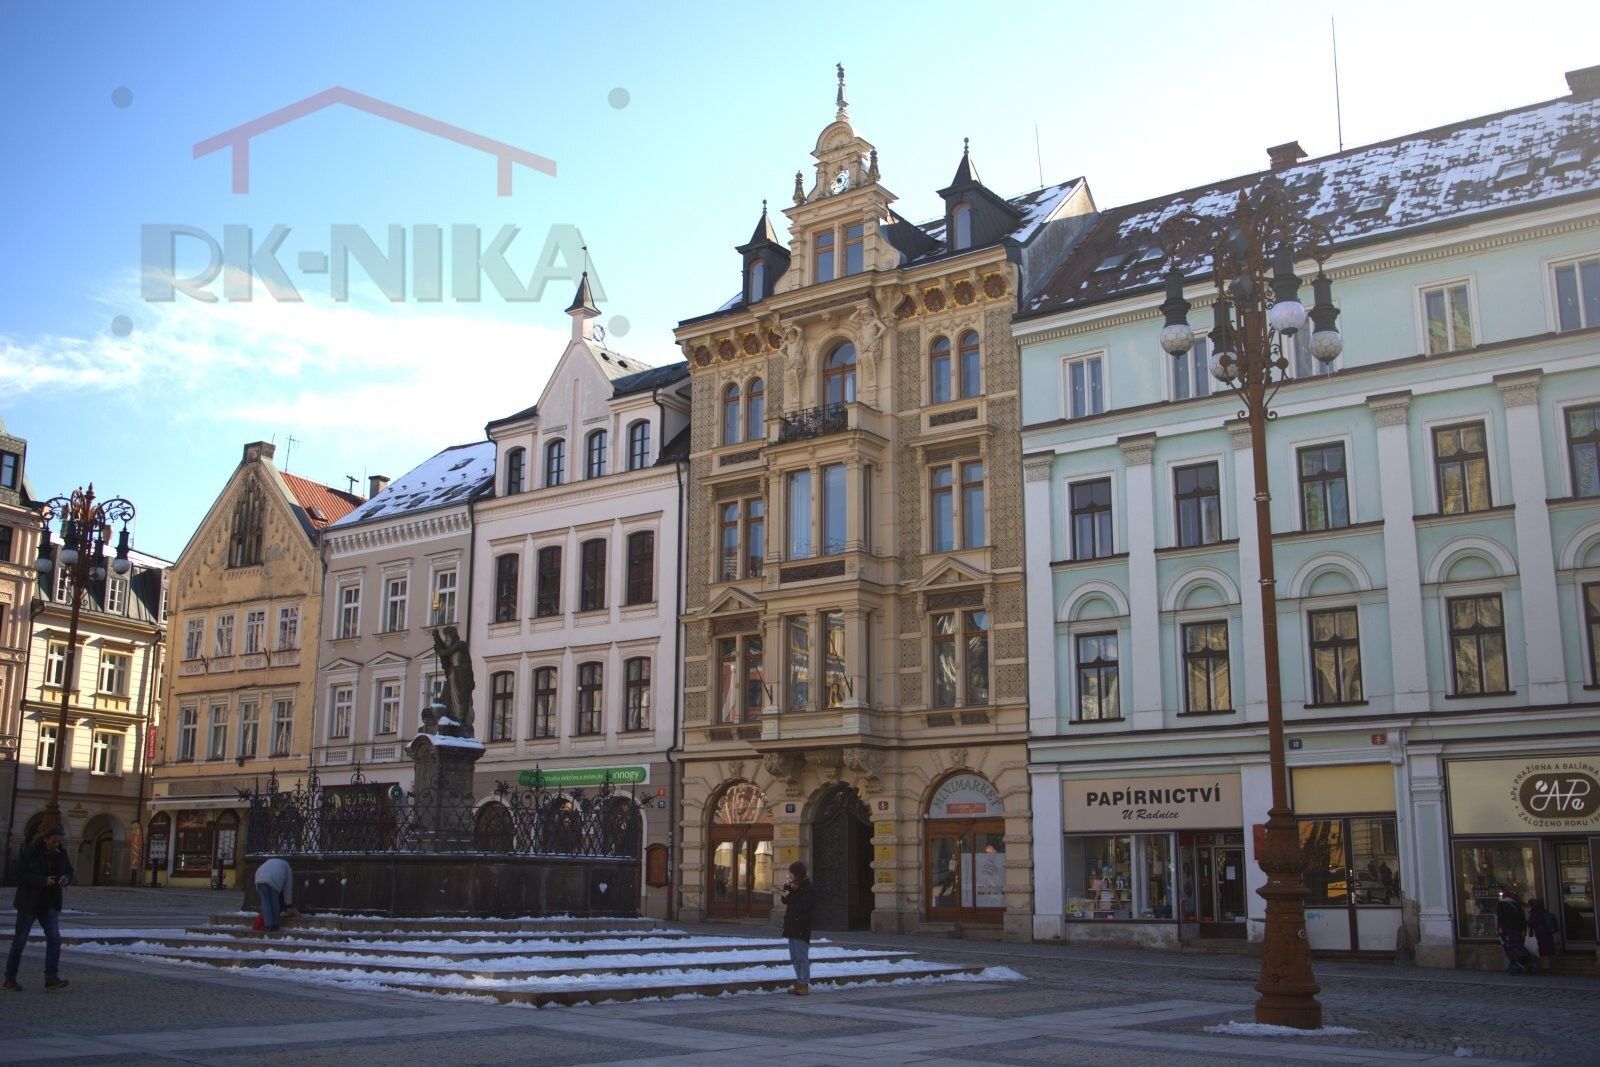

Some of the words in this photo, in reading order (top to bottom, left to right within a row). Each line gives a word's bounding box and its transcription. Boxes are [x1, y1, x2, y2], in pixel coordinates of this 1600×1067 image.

[612, 770, 639, 781] innogy
[1563, 762, 1599, 776] BALÍRNA
[934, 779, 1001, 809] MINIMARKET
[1086, 783, 1221, 806] PAPÍRNICTVÍ
[1122, 809, 1133, 820] U
[1136, 808, 1180, 820] Radnice
